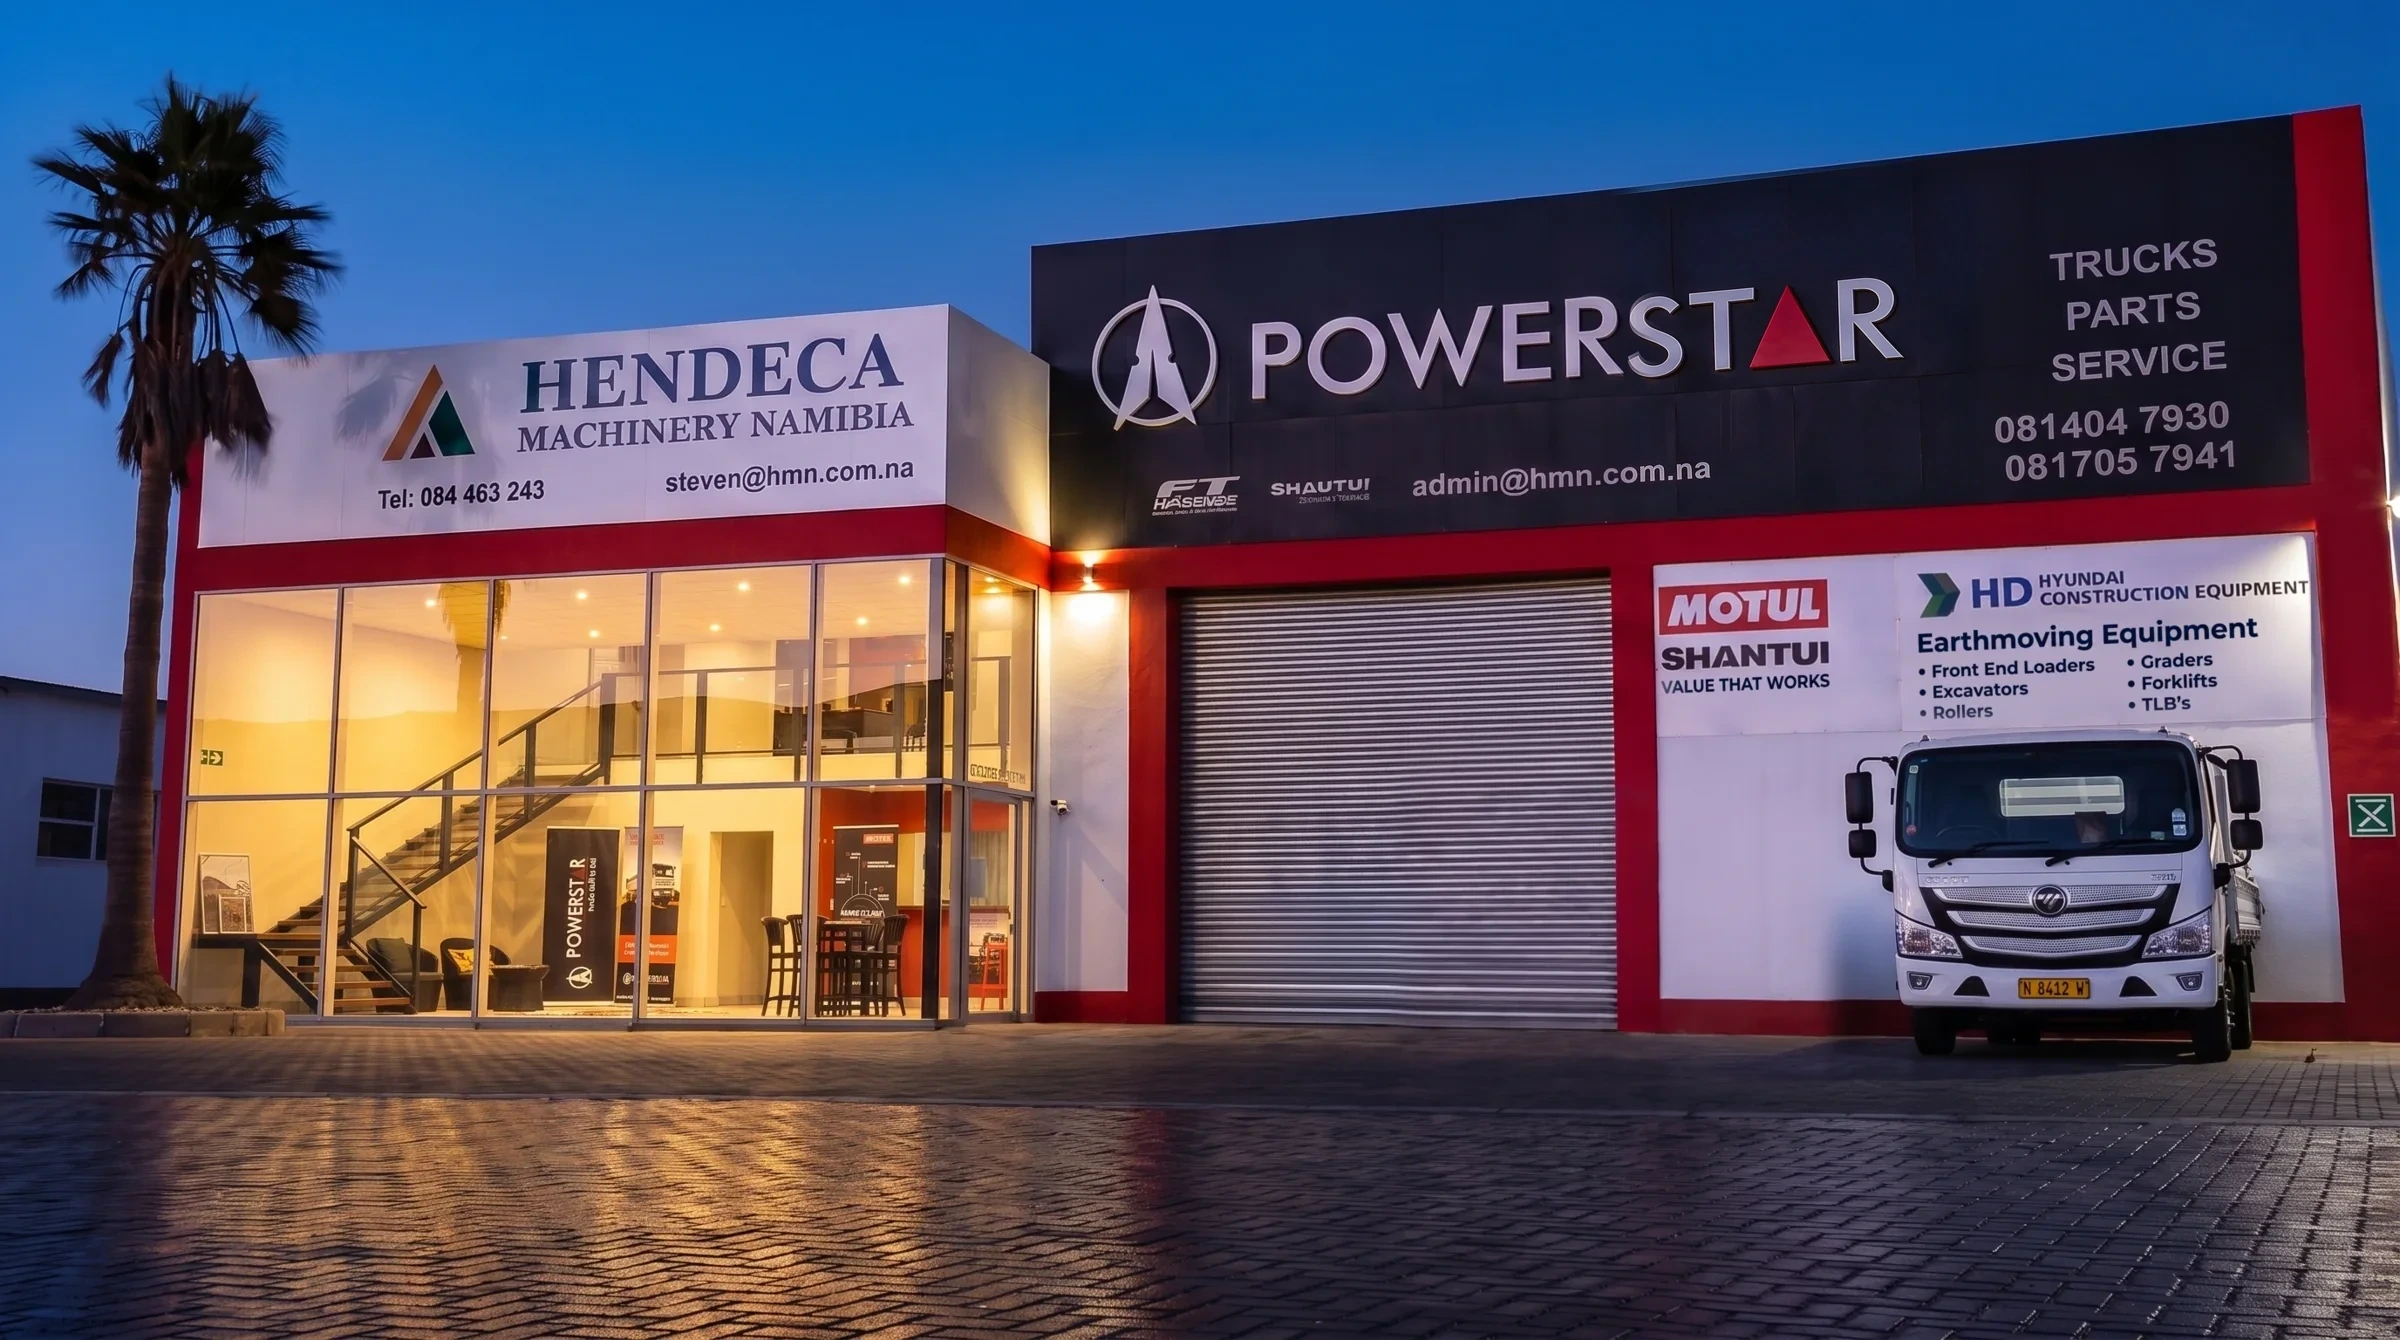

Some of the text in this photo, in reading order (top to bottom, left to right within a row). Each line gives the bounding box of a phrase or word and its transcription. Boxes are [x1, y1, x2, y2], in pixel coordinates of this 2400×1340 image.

[2050, 239, 2218, 281] TRUCKS
[2067, 292, 2201, 331] PARTS
[520, 333, 904, 414] HENDECA
[2052, 341, 2227, 382] SERVICE
[517, 401, 914, 453] MACHINERY NAMIBIA
[1995, 401, 2229, 443] 081404 7930
[2005, 440, 2235, 481] 081705 7941
[665, 461, 914, 493] steven@hmn.com.na
[1412, 461, 1711, 496] admin@hmn.com.na
[378, 479, 545, 510] Tel: 084 463 243
[1972, 576, 2033, 609] HD
[2039, 570, 2125, 588] HYUNDAI
[2039, 579, 2309, 607] CONSTRUCTION EQUIPMENT
[1667, 588, 1820, 626] MOTUL
[1917, 618, 2259, 654] Earthmoving Equipment
[1661, 641, 1830, 670] SHANTUI
[1932, 658, 2096, 679] Front End Loaders
[2141, 653, 2213, 669] Graders
[1661, 673, 1831, 695] VALUE THAT WORKS
[1932, 682, 2029, 699] Excavators
[2142, 673, 2218, 691] Forklifts
[1933, 704, 1994, 720] Rollers
[2023, 980, 2084, 996] N 8412 W
